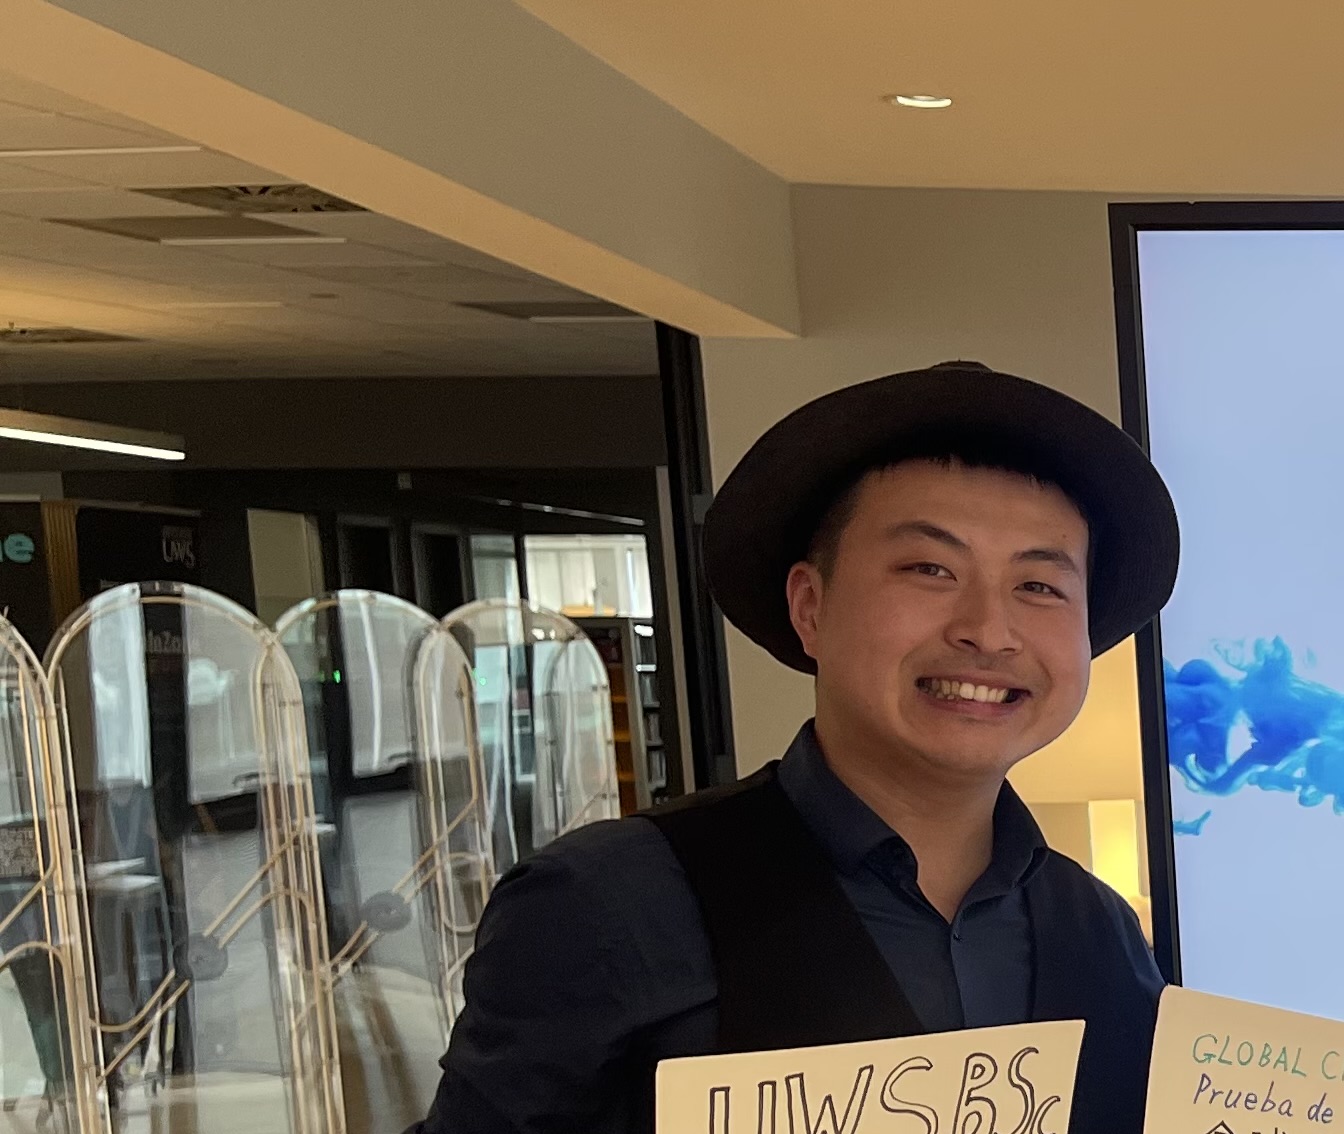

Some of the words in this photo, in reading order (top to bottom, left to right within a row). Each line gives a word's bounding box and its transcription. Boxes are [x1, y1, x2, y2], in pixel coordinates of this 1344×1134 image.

[0, 533, 35, 564] e
[1192, 1032, 1308, 1078] GLOBAL
[1193, 1073, 1293, 1117] Prueba
[1307, 1092, 1334, 1124] de
